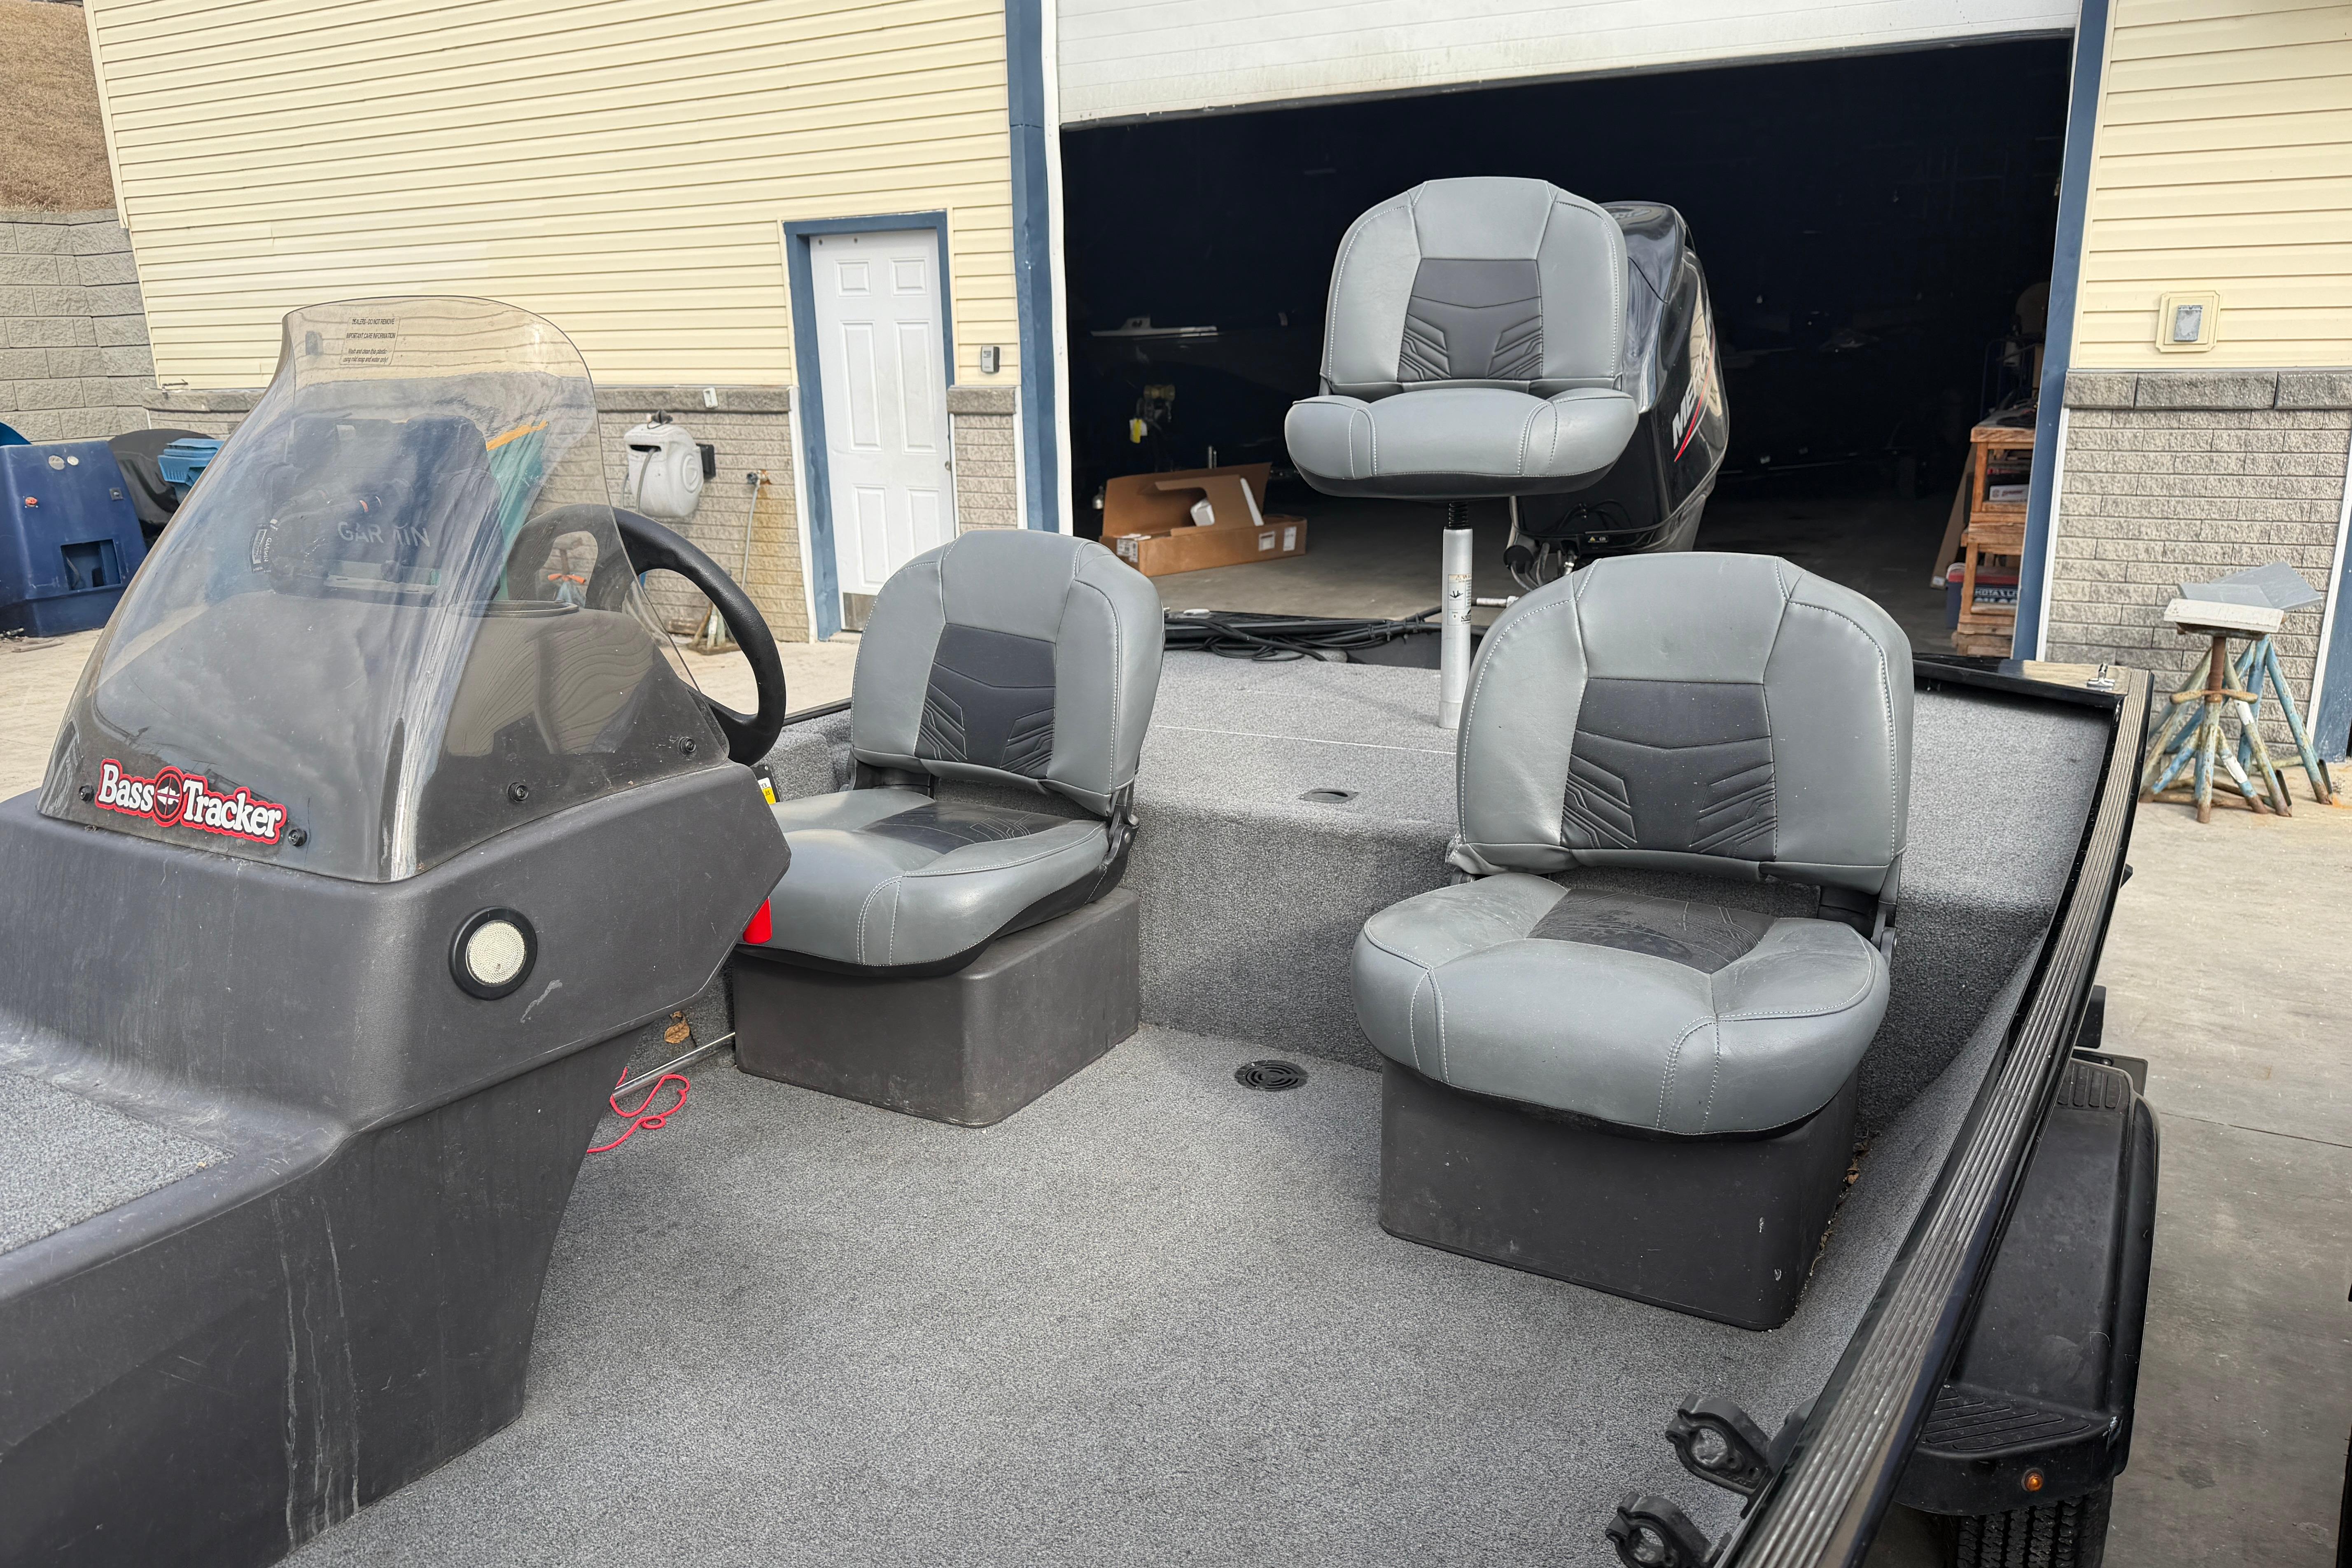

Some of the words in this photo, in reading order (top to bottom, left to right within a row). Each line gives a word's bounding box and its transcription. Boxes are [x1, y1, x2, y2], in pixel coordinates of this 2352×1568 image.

[263, 537, 272, 562] GARMIN
[98, 764, 155, 812] Bass
[183, 779, 282, 838] Tracker
